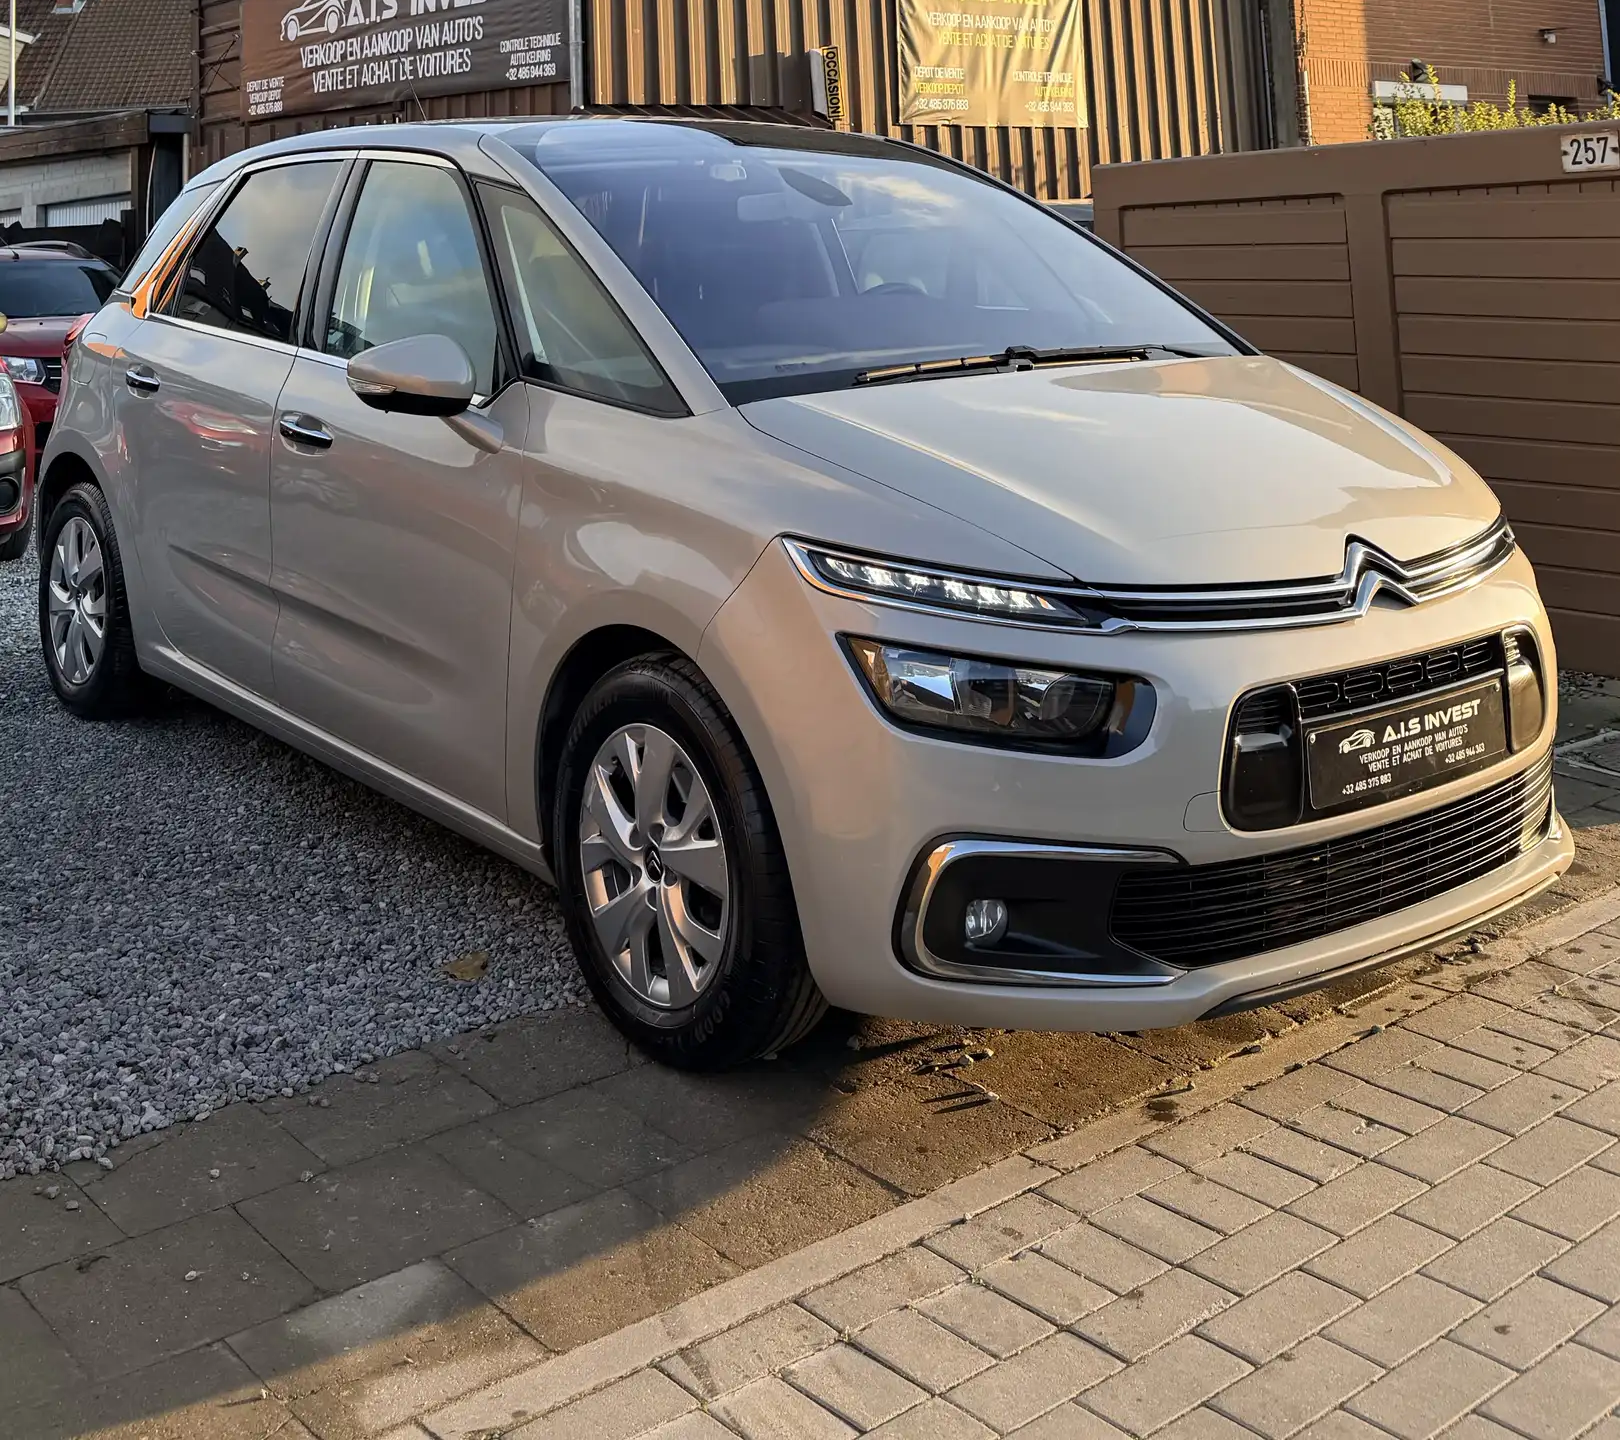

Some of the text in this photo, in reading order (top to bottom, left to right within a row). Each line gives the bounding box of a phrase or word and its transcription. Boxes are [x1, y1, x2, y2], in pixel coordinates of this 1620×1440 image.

[926, 11, 962, 27] VERKOOP
[962, 14, 974, 28] EN
[975, 15, 1011, 31] AANKOOP
[300, 16, 483, 69] VERKOOP EN AANKOOP VAN AUTO'S
[500, 32, 561, 53] CONTROLE TECHNIQUE
[938, 30, 1050, 50] VENTE ET ACAT DE VITUES
[510, 49, 551, 65] AUTO KEURING
[313, 48, 471, 93] VENTE ET ACHAT DE VOITURES
[505, 63, 556, 80] +32 485 944 363
[915, 66, 965, 80] DEPOT DE VENTE
[262, 79, 269, 90] DE
[826, 51, 841, 114] OCCASION
[915, 82, 965, 95] VERKOOP DEPOT
[915, 98, 928, 110] +32
[943, 99, 956, 110] 375
[956, 99, 969, 111] 883
[1024, 101, 1037, 112] +32
[1570, 137, 1609, 165] 257
[1382, 698, 1481, 743] A.I.S INVEST
[1359, 723, 1469, 765] VERKOOP EN AANKOOP VAN AUTO'S
[1368, 736, 1463, 773] VENTE ET ACHAT DE VOITURES
[1445, 753, 1456, 764] +32
[1342, 772, 1392, 795] +32 485 375 883
